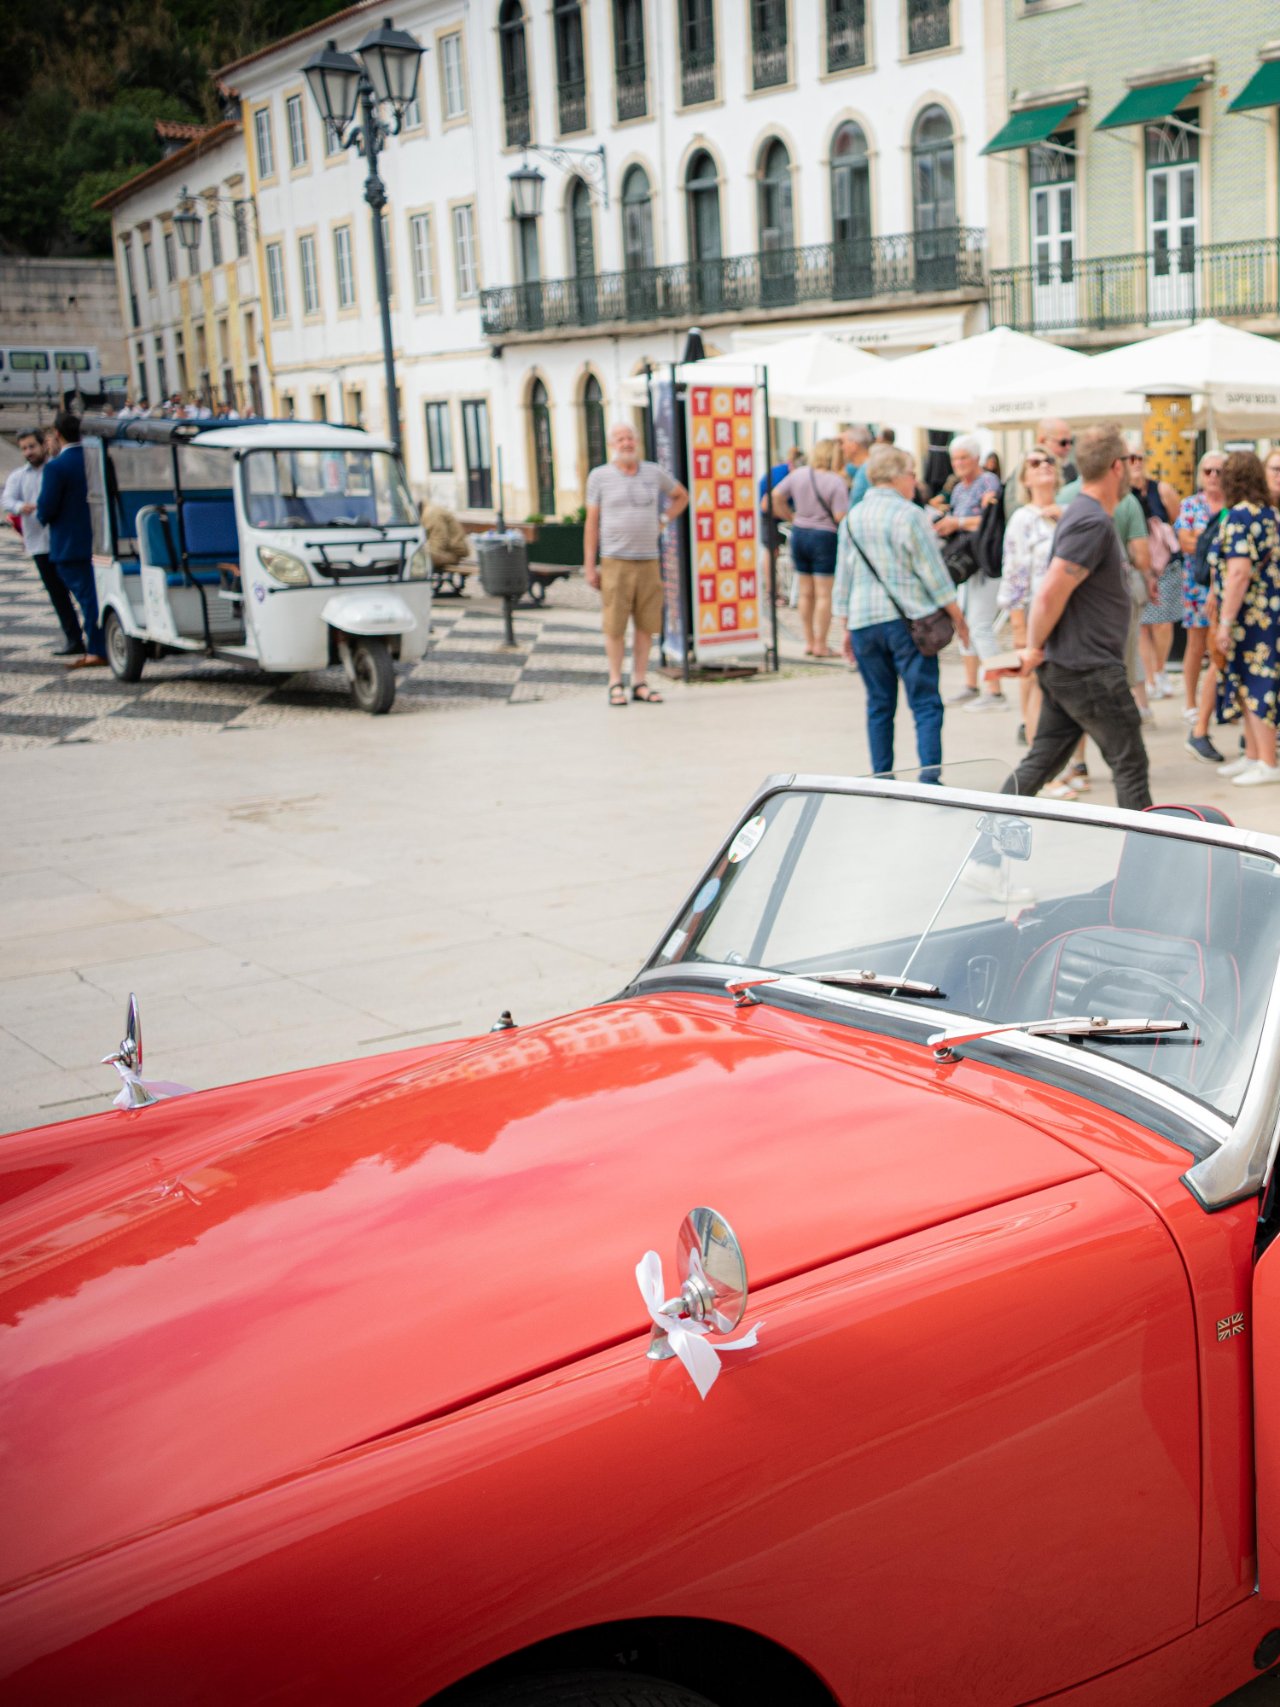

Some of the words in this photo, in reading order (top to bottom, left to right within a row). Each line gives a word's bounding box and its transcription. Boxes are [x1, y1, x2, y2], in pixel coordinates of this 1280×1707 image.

[694, 391, 750, 414] TOM
[696, 454, 751, 476] TOM
[698, 515, 752, 538] TOM
[700, 575, 754, 600] TOM
